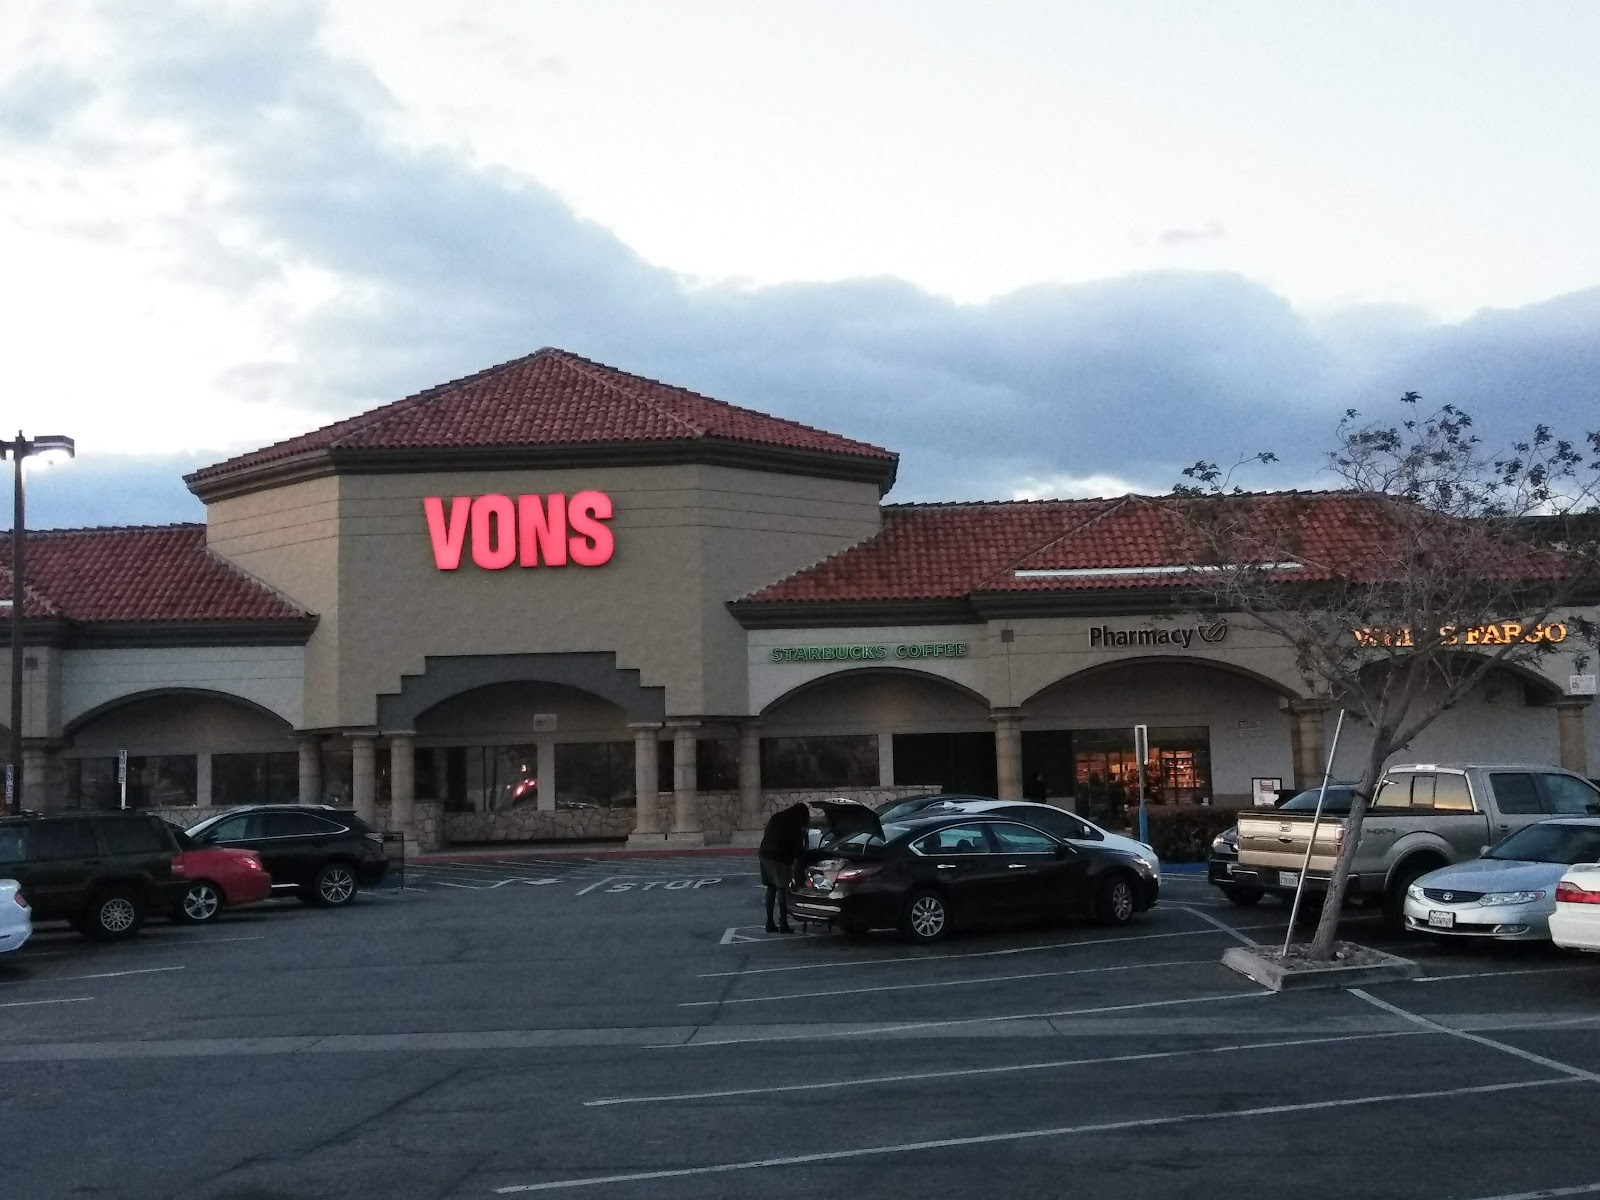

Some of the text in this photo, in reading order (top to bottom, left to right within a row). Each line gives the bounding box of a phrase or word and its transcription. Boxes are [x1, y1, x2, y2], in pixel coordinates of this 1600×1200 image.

[423, 490, 614, 570] VONS
[1089, 625, 1193, 649] Pharmacy
[1464, 621, 1567, 645] FARGO
[771, 643, 966, 661] STARBUCKS COFFEE
[604, 877, 723, 893] STOP
